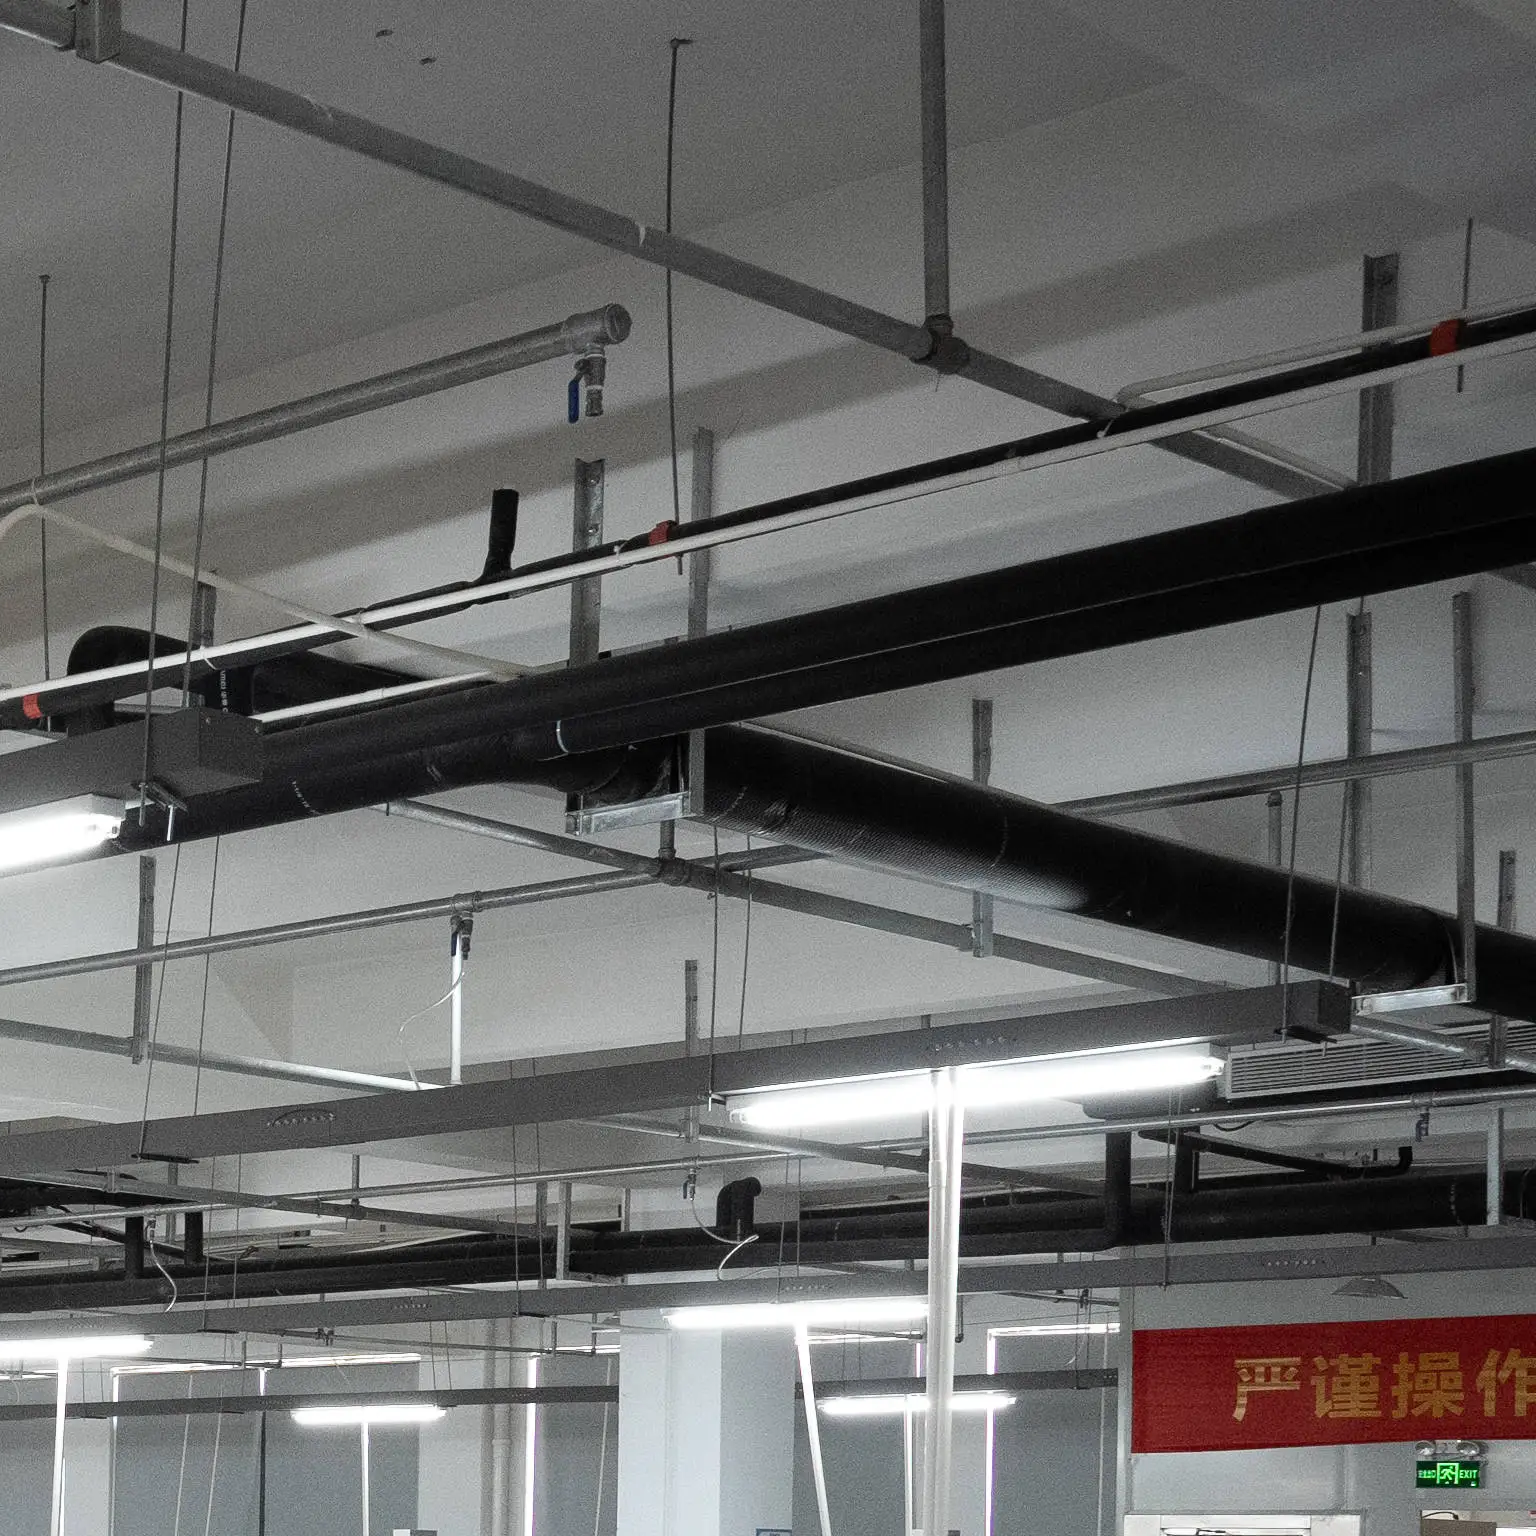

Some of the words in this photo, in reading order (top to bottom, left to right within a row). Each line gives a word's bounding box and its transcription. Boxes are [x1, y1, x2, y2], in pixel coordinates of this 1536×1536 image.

[1231, 1348, 1536, 1422] 严谨操作
[1459, 1469, 1478, 1479] EXIT
